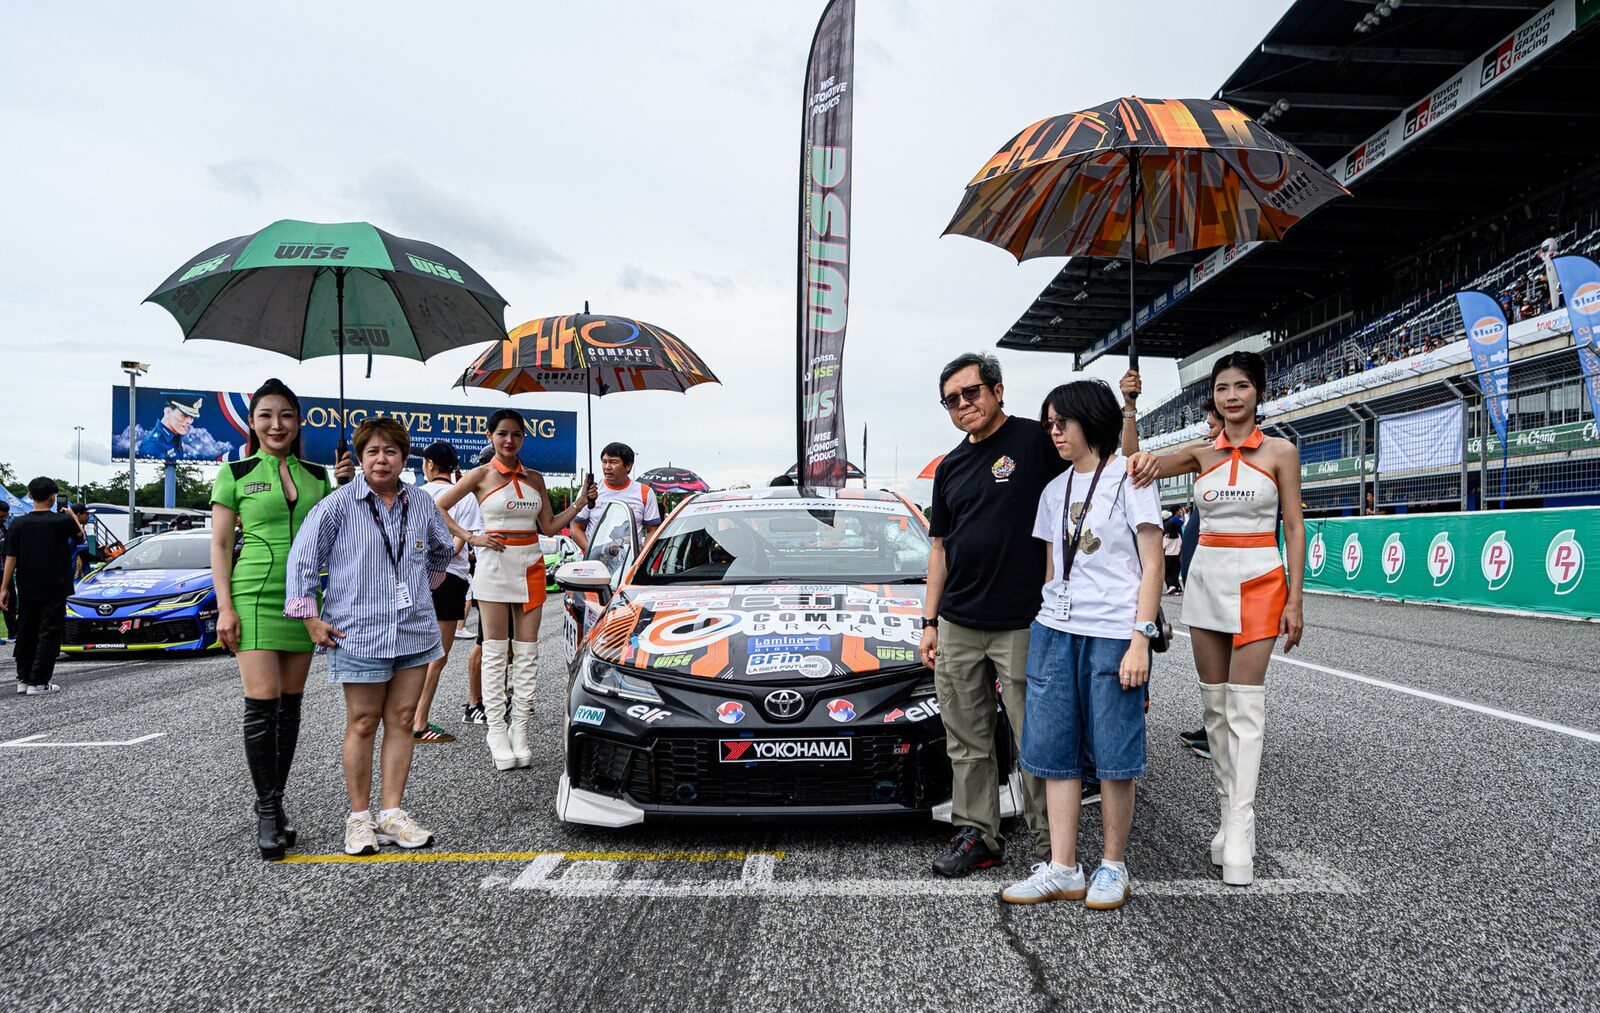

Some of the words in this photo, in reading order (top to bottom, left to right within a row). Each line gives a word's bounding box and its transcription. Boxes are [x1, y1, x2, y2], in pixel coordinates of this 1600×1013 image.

[1516, 8, 1555, 41] TOYOTA
[1514, 22, 1551, 52] GAZOO
[1513, 34, 1549, 64] Racing
[1480, 45, 1514, 88] GR
[1432, 77, 1463, 102] TOYOTA
[1430, 89, 1459, 112] GAZOO
[1429, 100, 1457, 122] Racing
[1403, 106, 1430, 141] GR
[1365, 139, 1387, 157] GAZOO
[1367, 129, 1390, 149] TOYOTA
[1344, 153, 1365, 181] GR
[1364, 148, 1386, 167] Racing
[1272, 171, 1312, 208] COMPACT
[274, 245, 350, 260] WISE
[408, 254, 465, 284] WISE
[588, 347, 653, 357] COMPACT
[590, 355, 652, 363] BRAKES
[536, 372, 587, 381] COMPACT
[301, 407, 368, 428] ONG
[438, 413, 488, 435] THE
[523, 418, 556, 438] NG
[753, 612, 923, 629] COMPACT
[753, 623, 922, 641] BRAKES
[653, 653, 694, 669] WISE
[750, 653, 801, 666] BFin
[877, 649, 915, 662] WISE
[748, 665, 778, 674] LASER
[626, 704, 672, 725] elf
[905, 697, 941, 722] elf
[752, 741, 848, 758] YOKOHAMA
